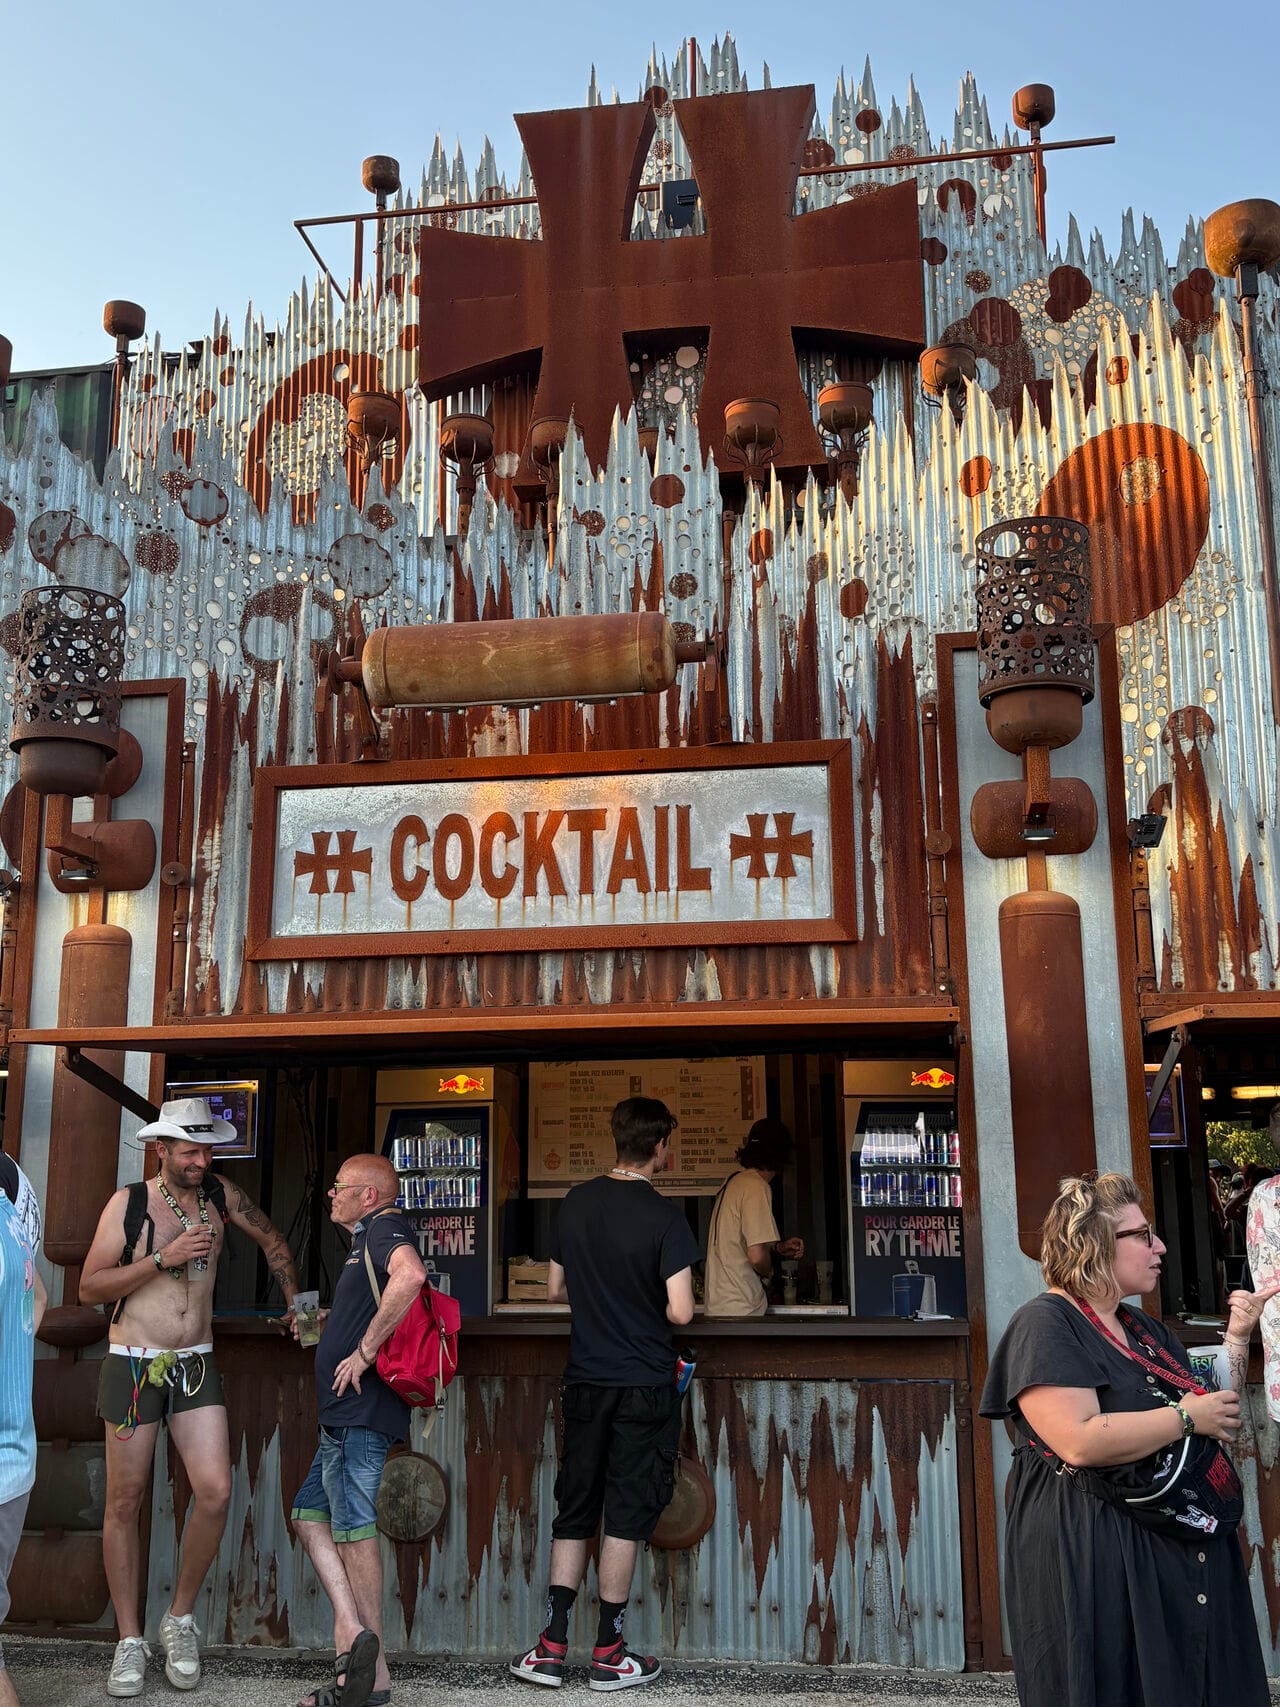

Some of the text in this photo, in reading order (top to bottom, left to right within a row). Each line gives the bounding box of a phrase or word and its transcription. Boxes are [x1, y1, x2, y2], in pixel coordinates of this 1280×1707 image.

[390, 803, 712, 902] COCKTAIL
[420, 1216, 462, 1230] GARDER
[464, 1215, 475, 1229] LE
[864, 1215, 960, 1229] POUR GARDER LE
[415, 1230, 475, 1256] THME
[864, 1229, 961, 1257] RYTHME
